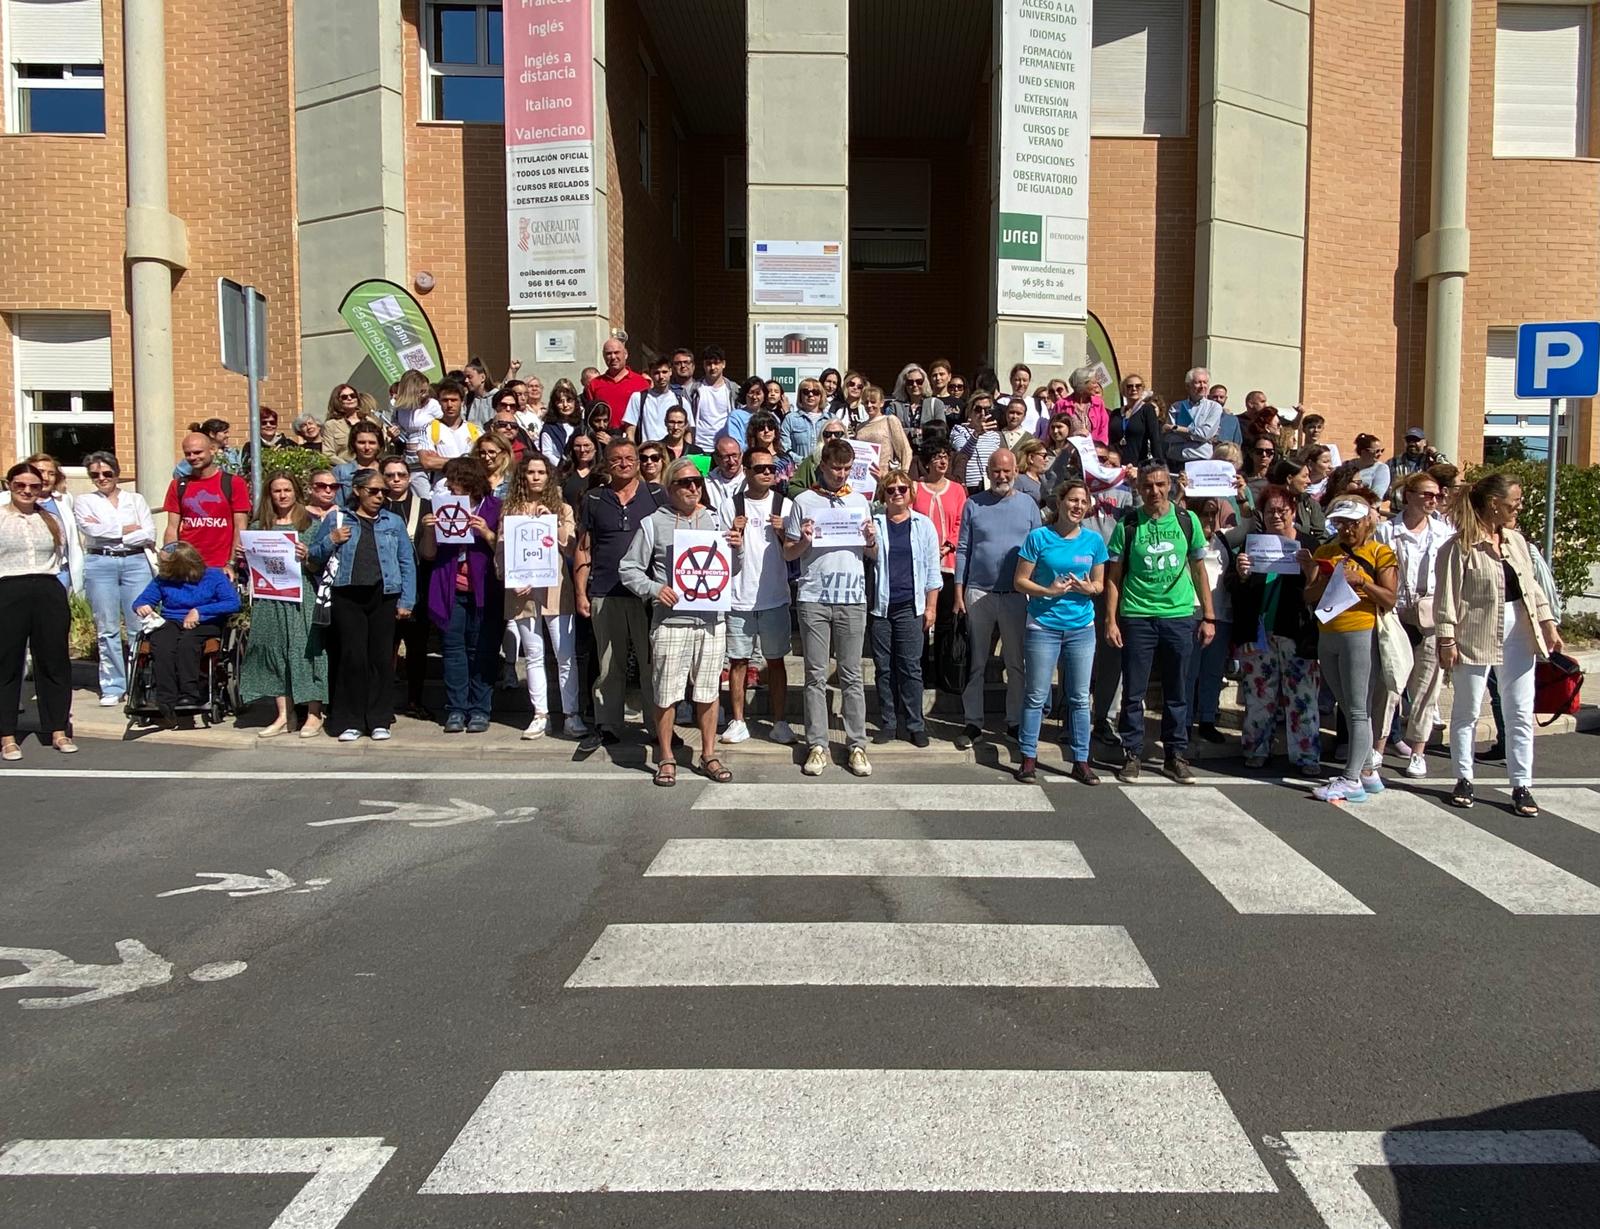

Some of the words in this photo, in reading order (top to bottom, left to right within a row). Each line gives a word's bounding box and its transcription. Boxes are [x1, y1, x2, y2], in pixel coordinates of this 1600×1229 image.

[1022, 0, 1054, 10] ACCESO
[1056, 2, 1062, 11] A
[1065, 3, 1074, 13] LA
[1019, 9, 1077, 25] UNIVERSIDAD
[528, 19, 564, 36] Inglés
[1029, 28, 1066, 42] IDIOMAS
[1022, 45, 1072, 60] FORMACIÓN
[524, 51, 559, 69] Inglés
[564, 52, 571, 63] a
[1019, 56, 1075, 72] PERMANENTE
[519, 66, 576, 83] distancia
[1018, 75, 1041, 87] UNED
[1044, 78, 1075, 90] SENIOR
[525, 97, 572, 111] Italiano
[1024, 93, 1069, 107] EXTENSIÓN
[1014, 104, 1078, 120] UNIVERSITARIA
[515, 124, 586, 139] Valenciano
[1023, 123, 1056, 135] CURSOS
[1058, 127, 1070, 137] DE
[1028, 136, 1063, 148] VERANO
[516, 154, 558, 164] TITULACIÓN
[560, 152, 588, 160] OFICIAL
[1016, 152, 1075, 167] EXPOSICIONES
[516, 170, 540, 178] TODOS
[542, 168, 556, 176] LOS
[558, 166, 589, 175] NIVELES
[1013, 170, 1078, 185] OBSERVATORIO
[516, 183, 547, 192] CURSOS
[548, 180, 590, 189] REGLADOS
[1017, 183, 1028, 192] DE
[1030, 184, 1073, 196] IGUALDAD
[516, 196, 558, 205] DESTREZAS
[560, 193, 590, 202] ORALES
[531, 218, 579, 233] GENERALITAT
[531, 232, 580, 246] VALENCIANA
[1003, 229, 1038, 245] UNED
[519, 268, 586, 277] eoibenidorm.com
[1011, 264, 1075, 276] www.uneddenia.es
[544, 279, 553, 287] 81
[567, 278, 578, 286] 60
[1022, 278, 1031, 286] 96
[1032, 279, 1045, 288] 585
[1056, 280, 1064, 288] 26
[1002, 290, 1082, 302] info@benidorm.uned.es
[1533, 331, 1584, 389] P
